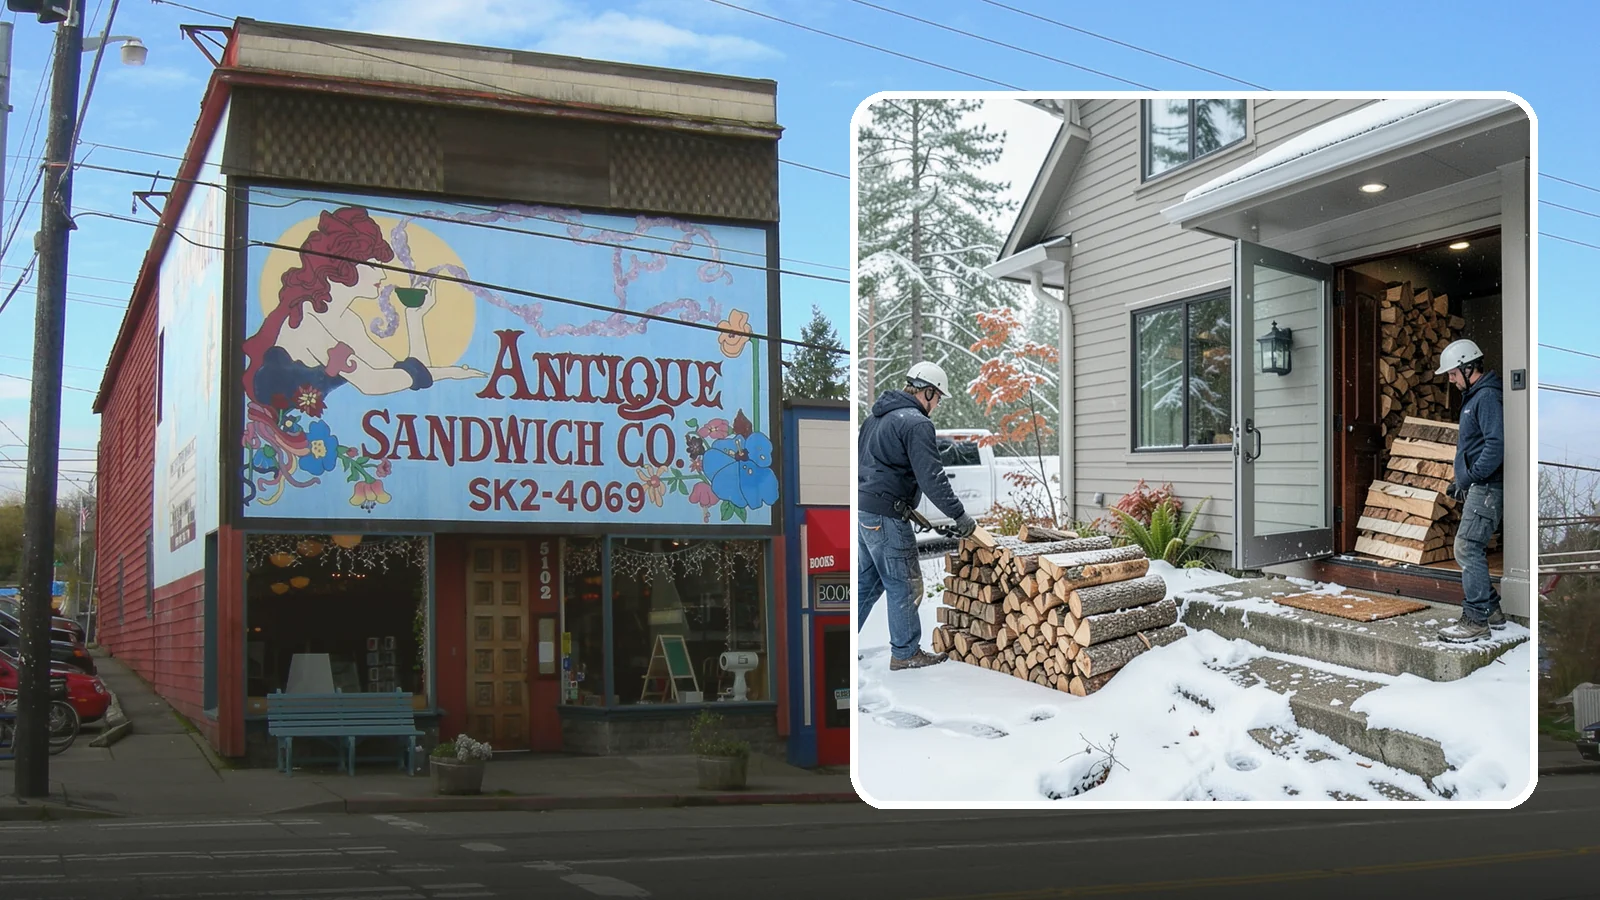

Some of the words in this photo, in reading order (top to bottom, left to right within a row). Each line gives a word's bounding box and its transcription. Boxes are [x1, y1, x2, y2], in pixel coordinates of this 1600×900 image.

[475, 329, 723, 420] ANTIQUE
[361, 408, 604, 467] SANDWICH
[617, 421, 685, 469] CO.
[468, 477, 646, 513] SK2-4069
[539, 541, 552, 600] 5102
[809, 555, 835, 569] BOOKS
